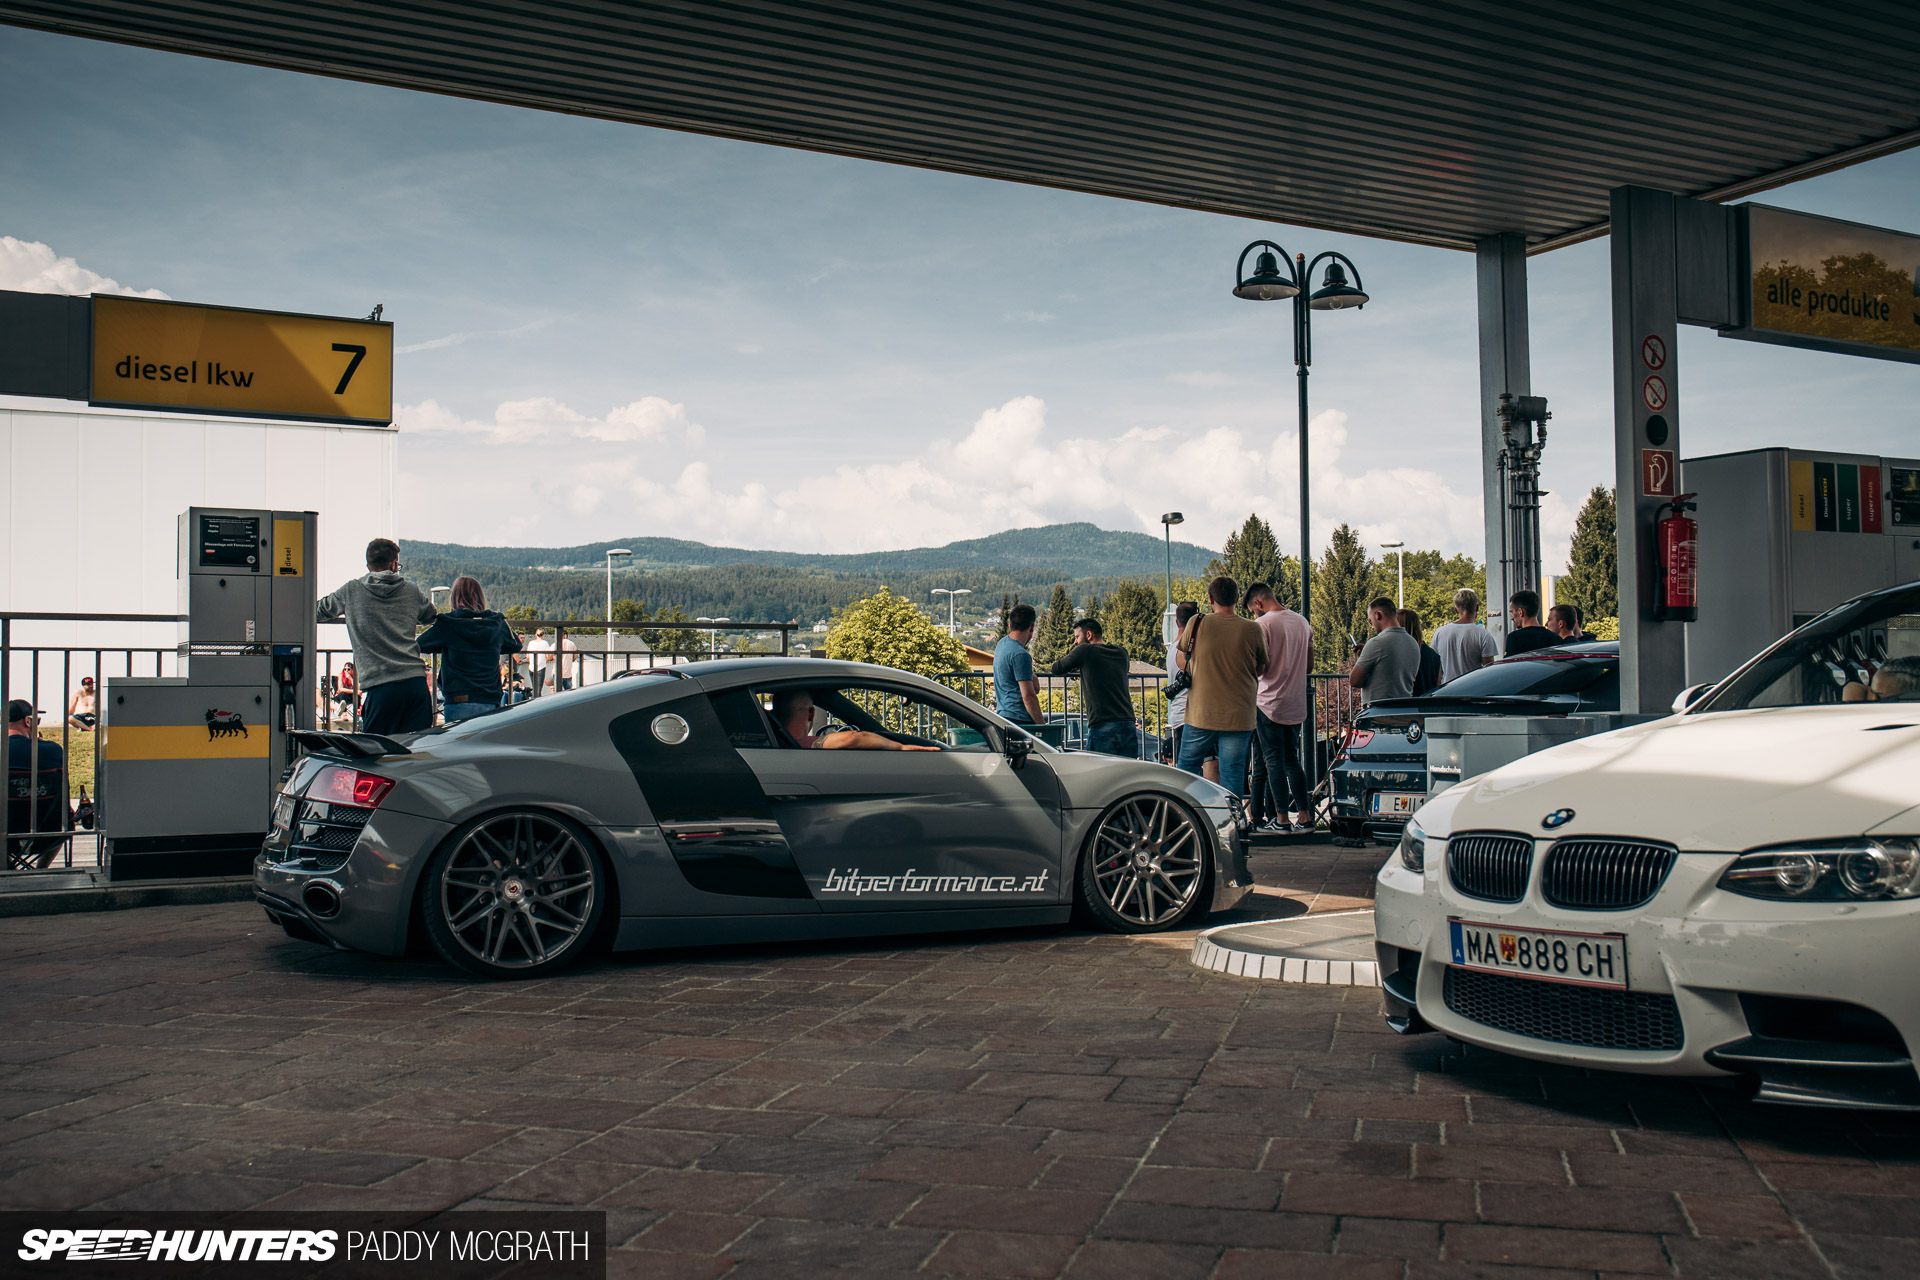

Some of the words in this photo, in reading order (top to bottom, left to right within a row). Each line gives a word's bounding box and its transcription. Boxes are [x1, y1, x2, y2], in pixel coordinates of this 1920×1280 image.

[1767, 278, 1802, 307] alle
[1808, 289, 1890, 322] produkte
[115, 355, 197, 384] diesel
[207, 362, 254, 388] lkw
[331, 342, 367, 395] 7
[1394, 797, 1400, 811] E
[820, 868, 1049, 896] bitperformance.at
[1455, 949, 1462, 958] A
[1466, 929, 1500, 966] MA
[1517, 936, 1569, 974] 888
[1576, 942, 1614, 979] CH
